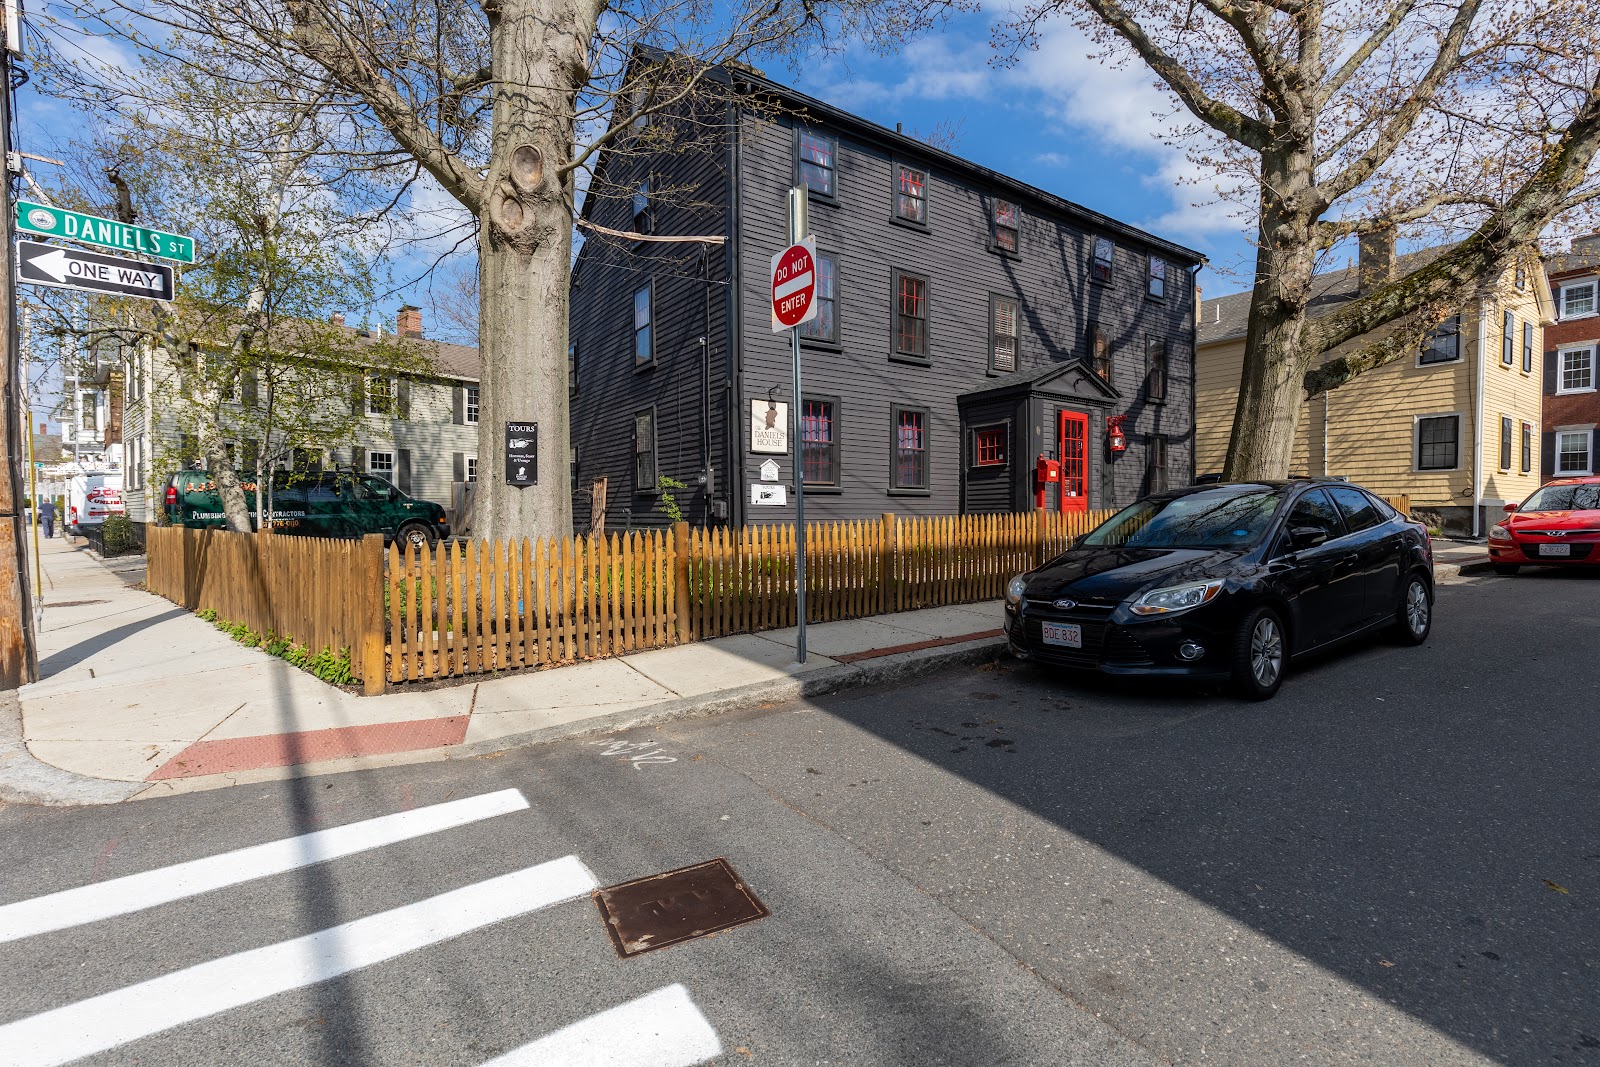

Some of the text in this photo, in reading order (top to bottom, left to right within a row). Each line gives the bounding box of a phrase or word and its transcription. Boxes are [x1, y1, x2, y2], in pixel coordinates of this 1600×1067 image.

[64, 214, 161, 253] DANIELS
[169, 241, 185, 254] ST
[69, 261, 157, 287] ONE WAY
[777, 255, 808, 281] DO NOT
[781, 293, 806, 314] ENTER
[754, 431, 785, 439] DANIELS
[756, 439, 783, 447] HOUSE
[1062, 629, 1079, 643] 832
